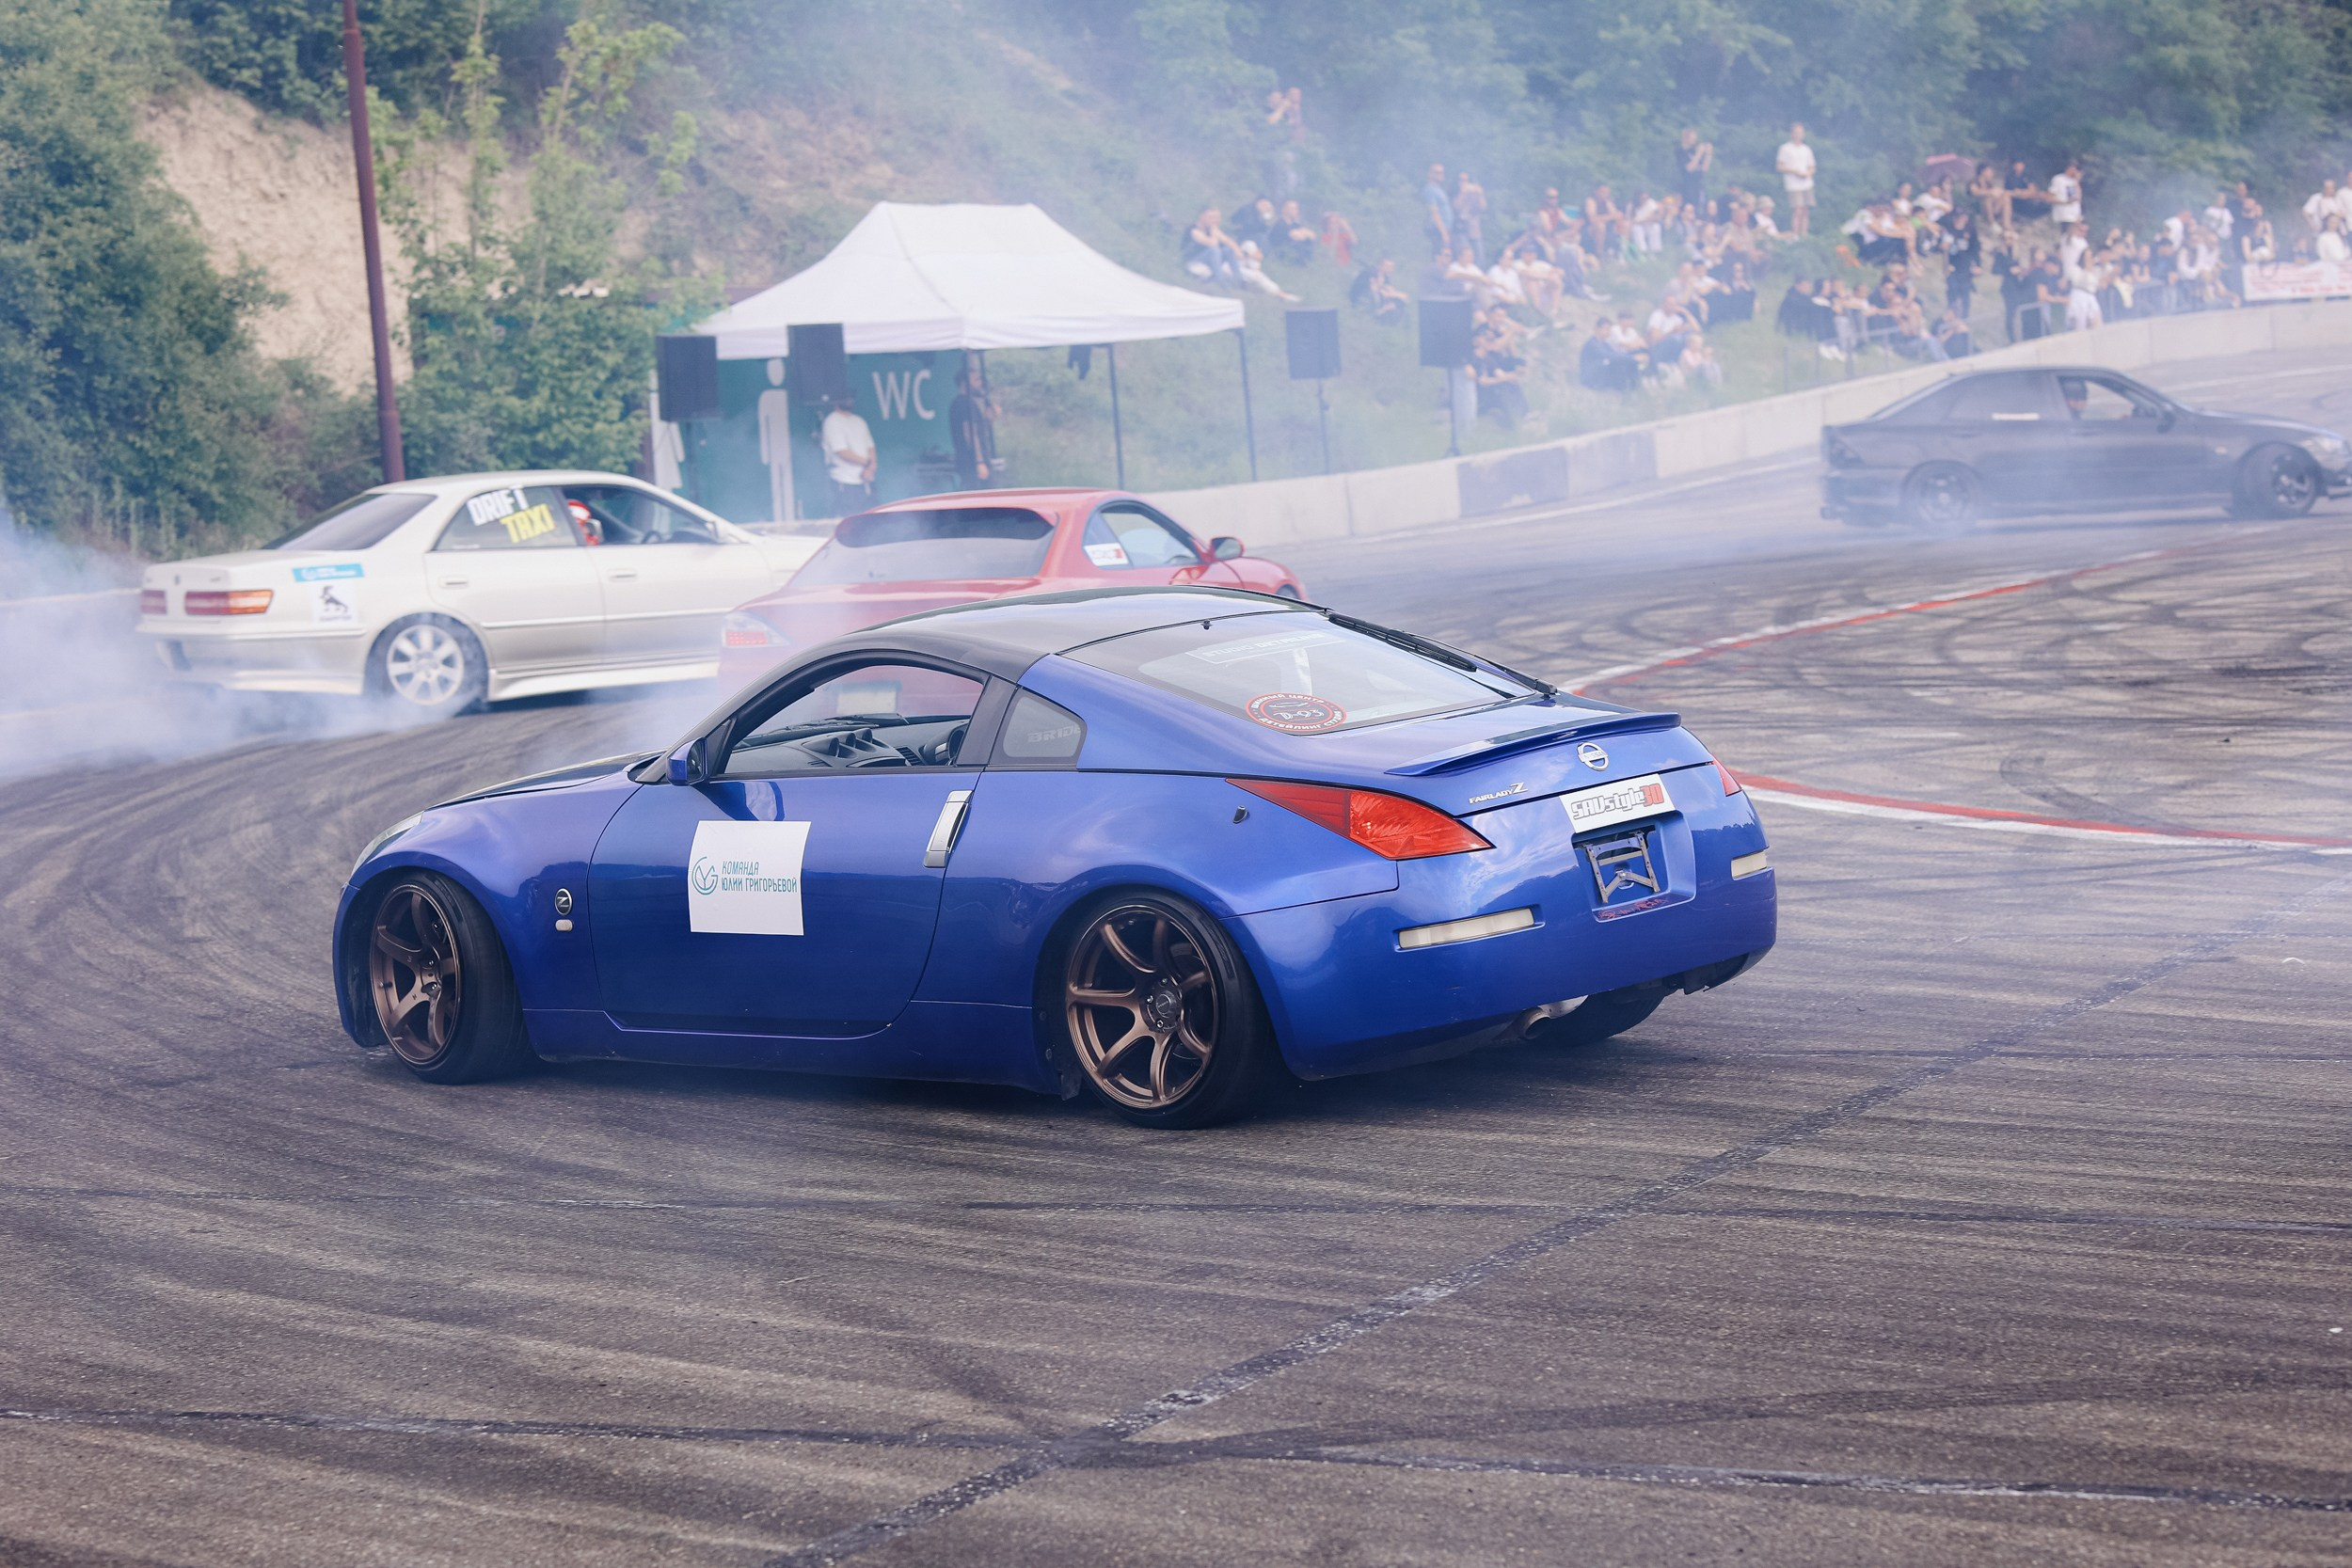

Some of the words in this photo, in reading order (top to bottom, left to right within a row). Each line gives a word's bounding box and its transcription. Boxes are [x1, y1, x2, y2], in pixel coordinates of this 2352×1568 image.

[872, 369, 935, 420] WC
[467, 485, 529, 526] DRIFT
[500, 503, 557, 544] TAXI
[722, 861, 760, 876] КОМАНДА
[722, 878, 743, 892] ЮЛИИ
[745, 878, 798, 893] ГРИГОРЬЕВОЙ
